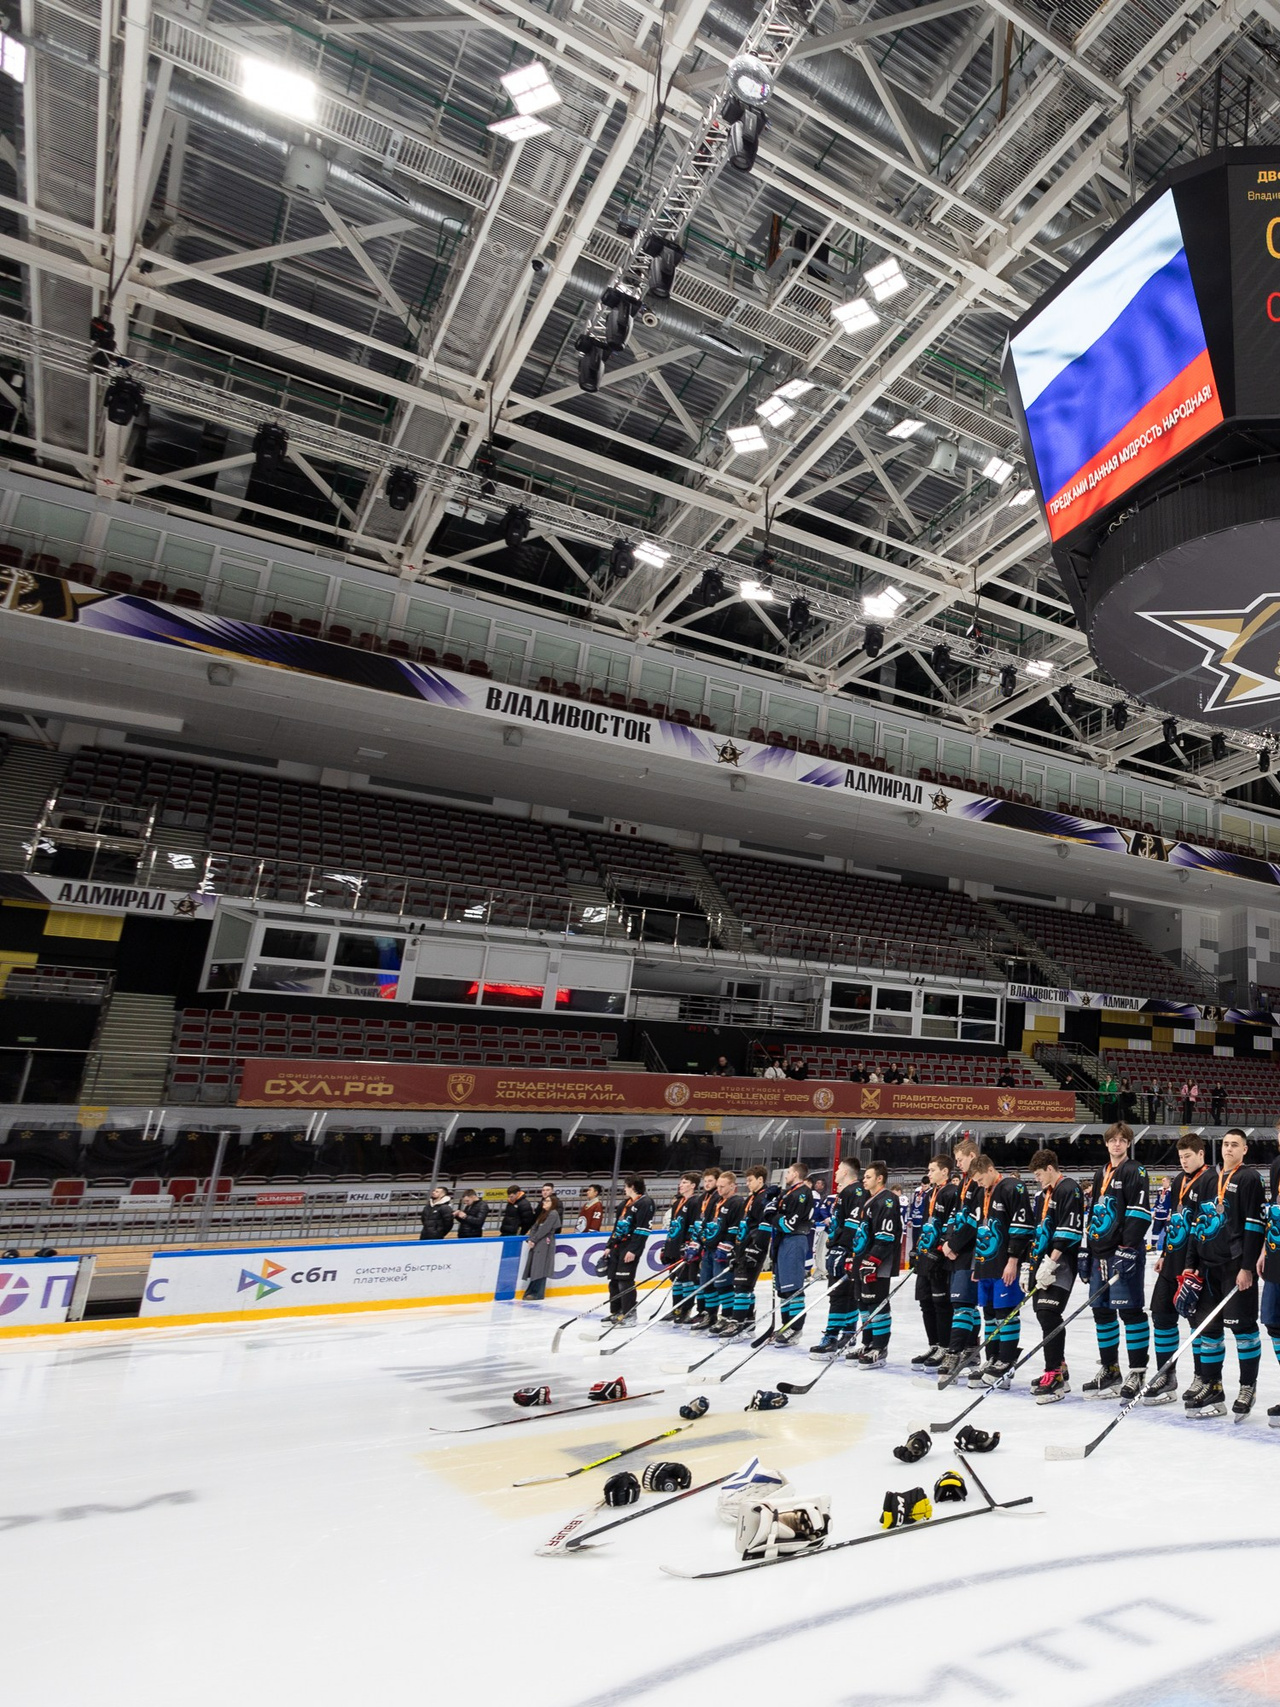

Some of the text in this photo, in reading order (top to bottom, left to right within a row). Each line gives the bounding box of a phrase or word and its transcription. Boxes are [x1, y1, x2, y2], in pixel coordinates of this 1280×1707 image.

[1049, 384, 1213, 516] ПРЕДКАМИ ДАННАЯ МУДРОСТЬ НАРОДНАЯ!
[485, 687, 651, 744] ВЛАДИВОСТОК
[845, 768, 923, 805] АДМИРАЛ
[58, 883, 167, 911] АДМИРАЛ
[1010, 984, 1069, 1002] ВЛАДИВОСТОК
[1103, 996, 1139, 1011] АДМИРАЛ
[278, 1073, 358, 1081] ОФИЦИАЛЬНЫЙ
[451, 1074, 474, 1083] СХЛ
[264, 1079, 394, 1097] СХЛ.РФ
[497, 1081, 614, 1092] СТУДЕНЧЕСКАЯ
[495, 1090, 626, 1101] ХОККЕЙНАЯ ЛИГА
[783, 1094, 810, 1102] 2025
[893, 1094, 974, 1103] ПРАВИТЕЛЬСТВО
[892, 1102, 963, 1110] ПРИМОРСКОГО
[349, 1192, 389, 1201] KHL.RU
[554, 1189, 578, 1197] огаз
[850, 1207, 860, 1218] 4
[789, 1214, 799, 1225] 5
[881, 1218, 894, 1232] 10
[355, 1262, 452, 1275] система быстрых
[290, 1267, 338, 1284] сбп
[353, 1273, 408, 1285] платежей
[545, 1519, 583, 1547] BAUER
